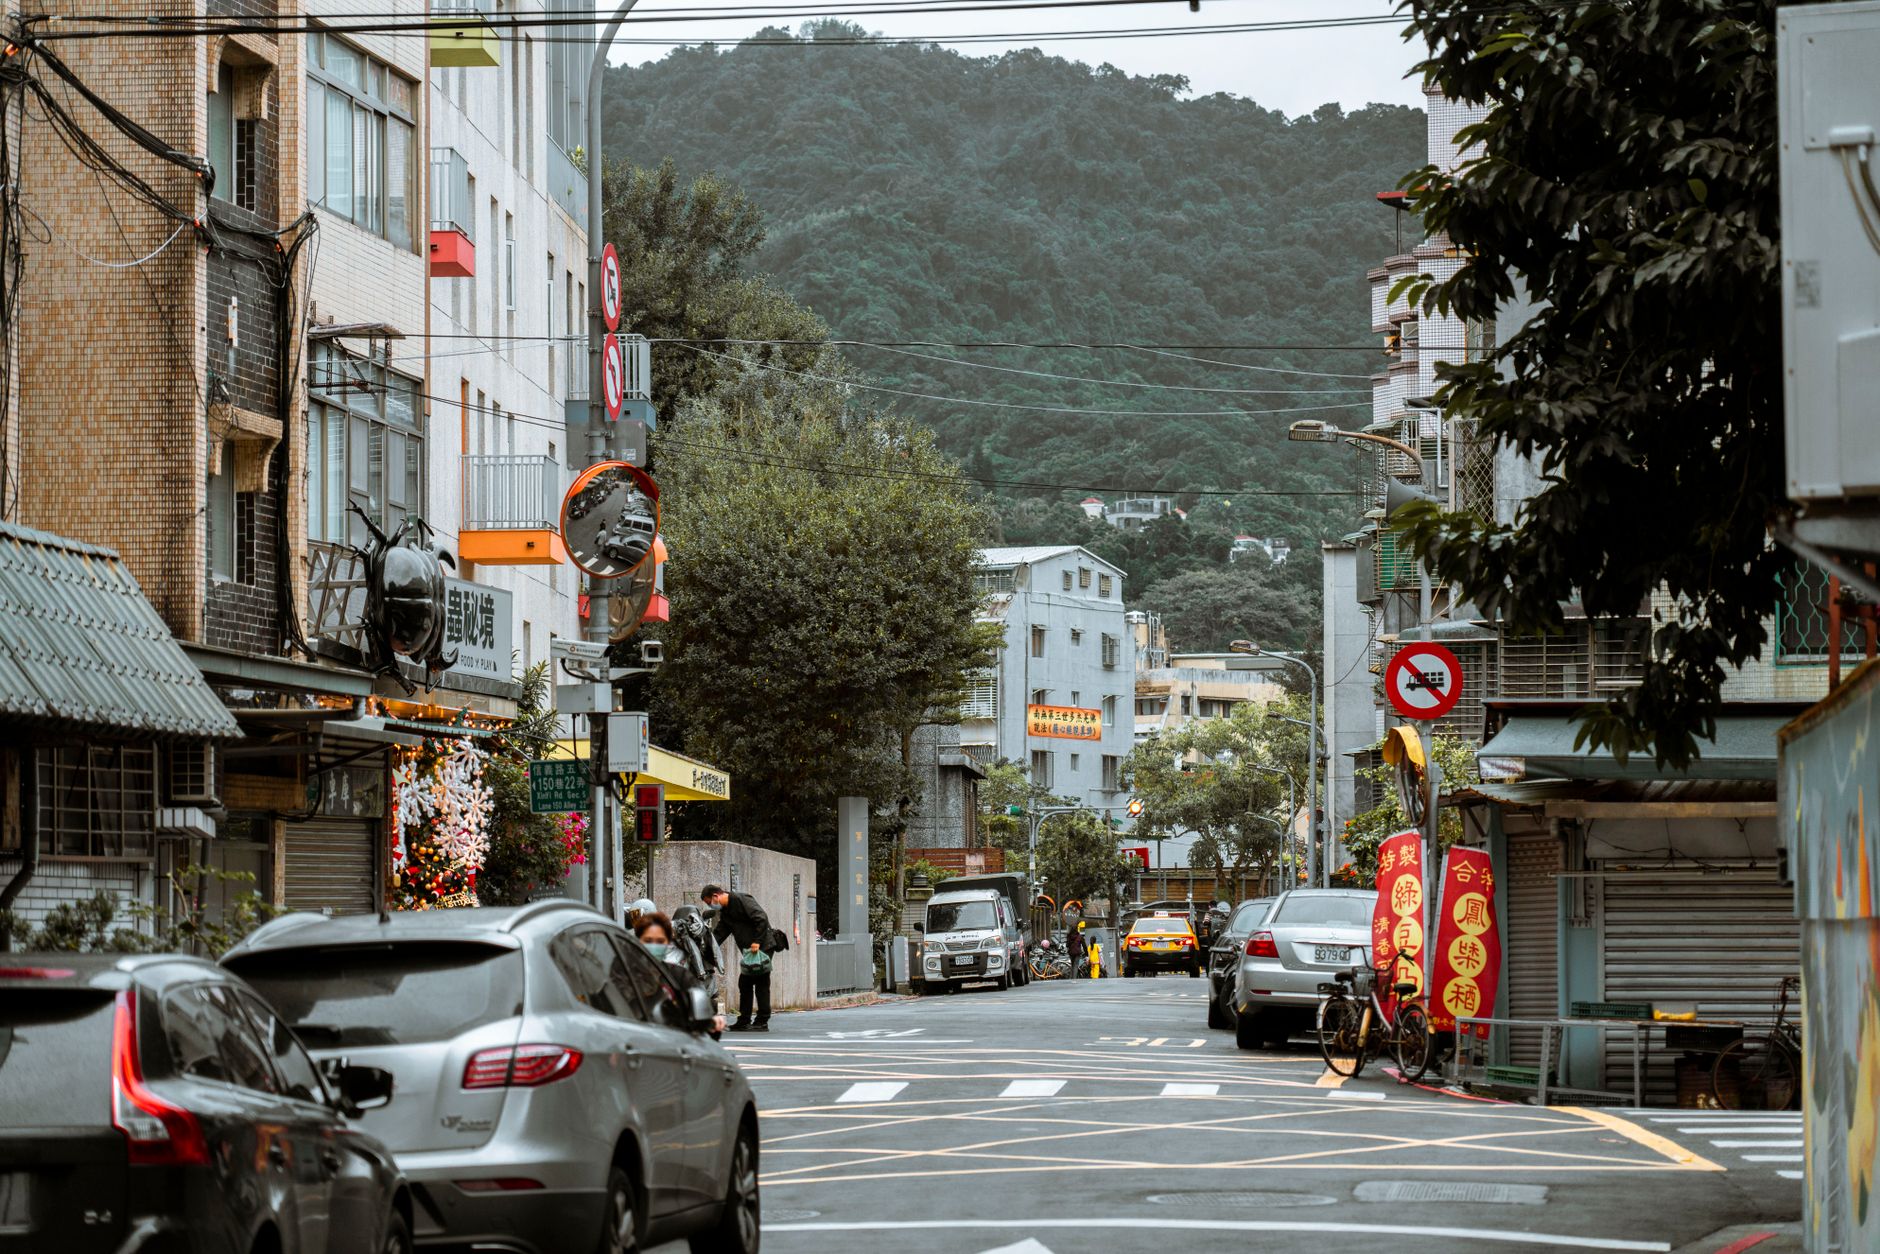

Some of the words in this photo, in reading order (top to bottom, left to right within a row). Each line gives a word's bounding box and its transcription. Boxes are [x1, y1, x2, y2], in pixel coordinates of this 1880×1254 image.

[461, 654, 474, 668] FOOD
[481, 659, 492, 671] PLAY
[1380, 844, 1418, 875] 特製
